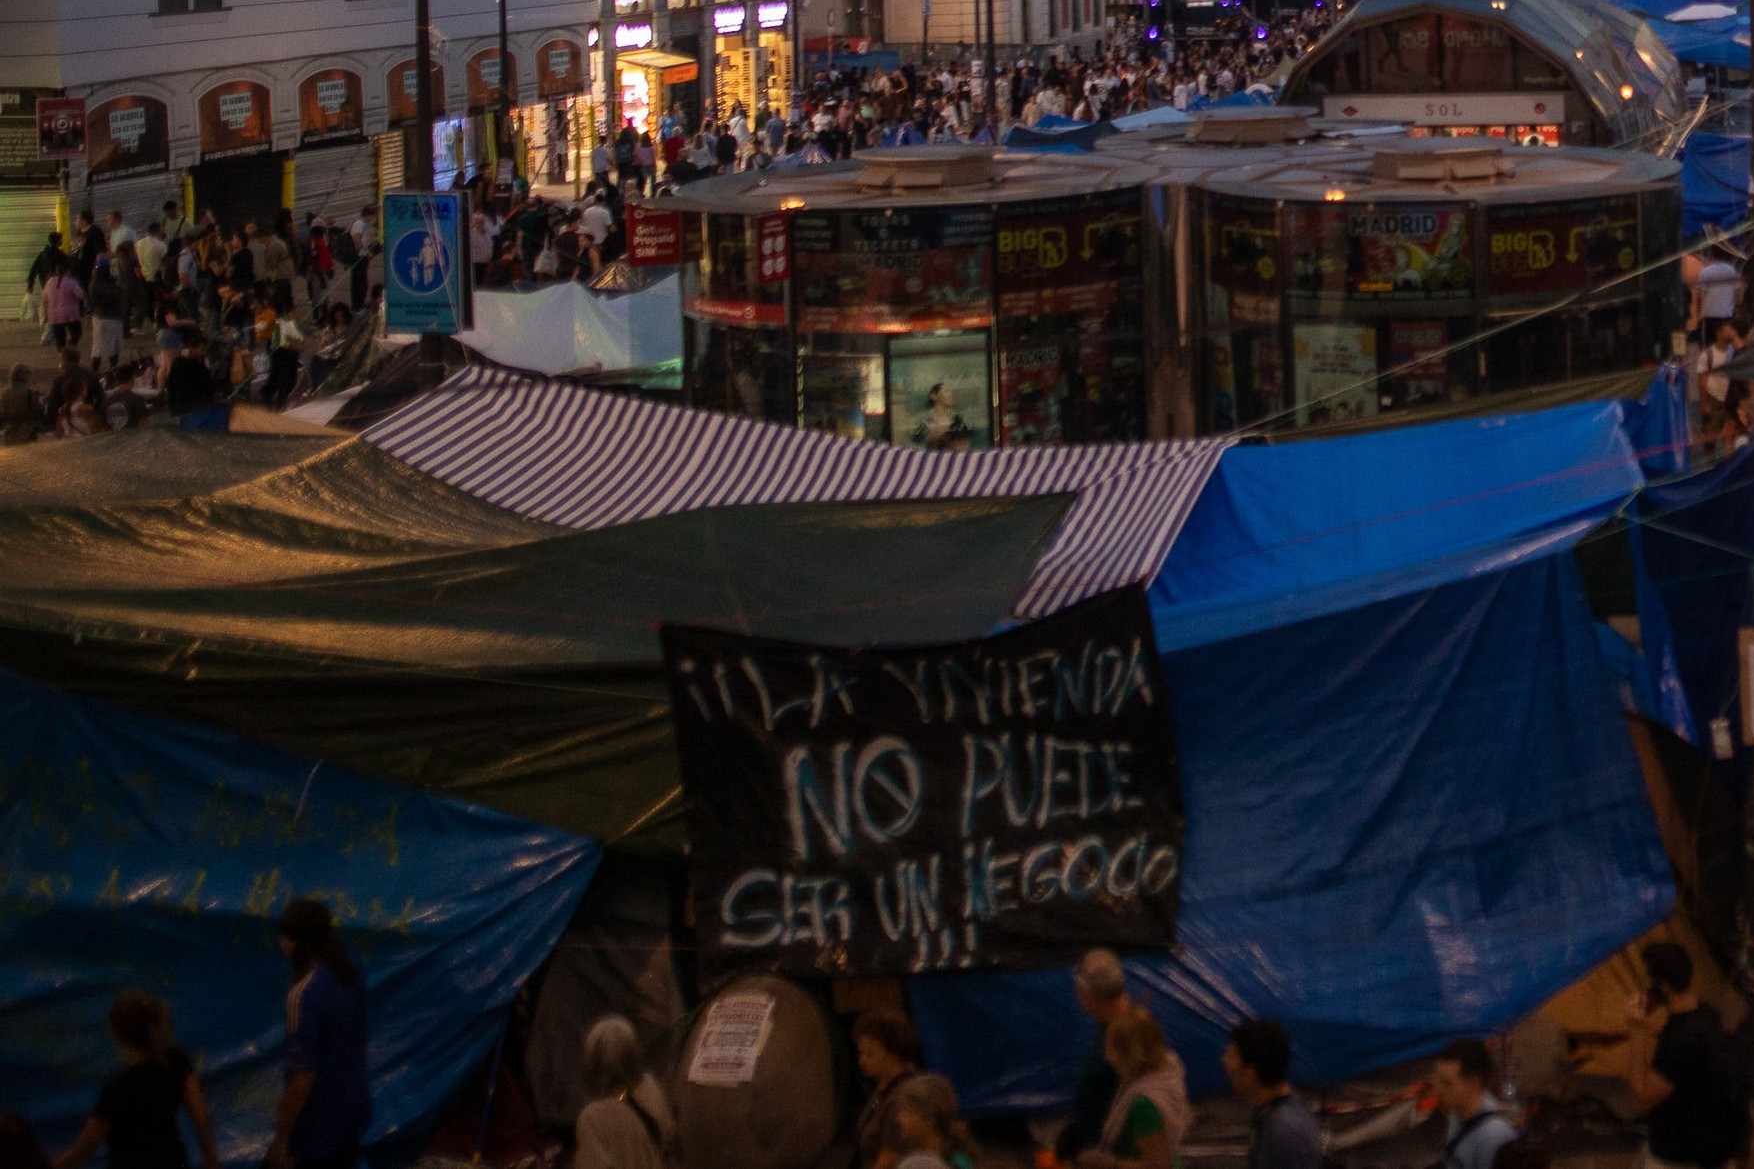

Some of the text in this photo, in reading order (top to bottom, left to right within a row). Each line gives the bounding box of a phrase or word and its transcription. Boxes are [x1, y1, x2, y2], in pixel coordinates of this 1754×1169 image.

[1426, 102, 1463, 117] SOL
[1351, 215, 1437, 233] MADRID
[997, 229, 1040, 253] BIG
[1491, 232, 1528, 255] BIG
[783, 733, 1145, 865] NO PUEDE
[721, 868, 853, 947] SER
[875, 853, 941, 941] UN
